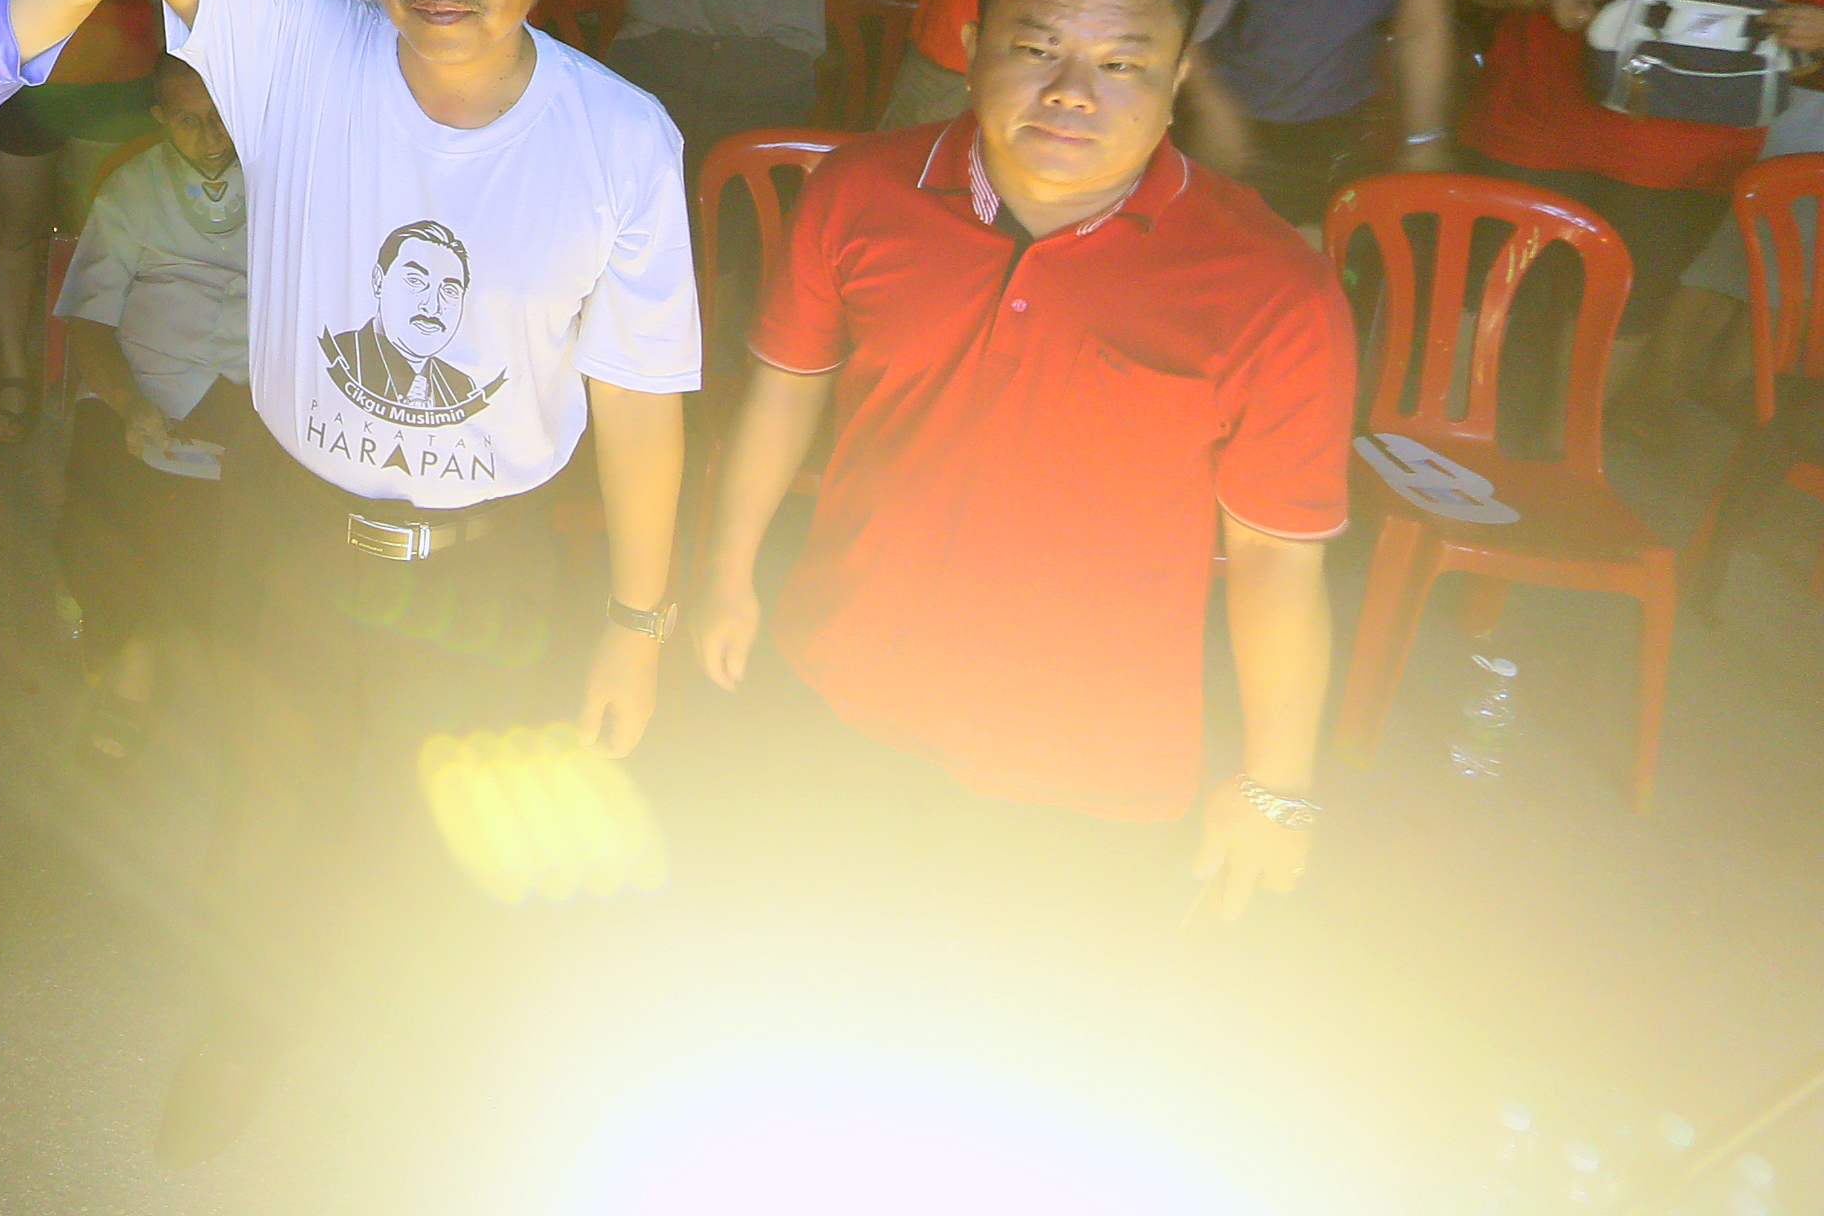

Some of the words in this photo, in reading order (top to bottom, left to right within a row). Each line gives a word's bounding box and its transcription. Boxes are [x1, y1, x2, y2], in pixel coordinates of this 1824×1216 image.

[311, 399, 492, 448] PAKATAN
[344, 381, 386, 416] Cikgu
[389, 407, 466, 425] Muslimin
[307, 416, 495, 481] HARAPAN
